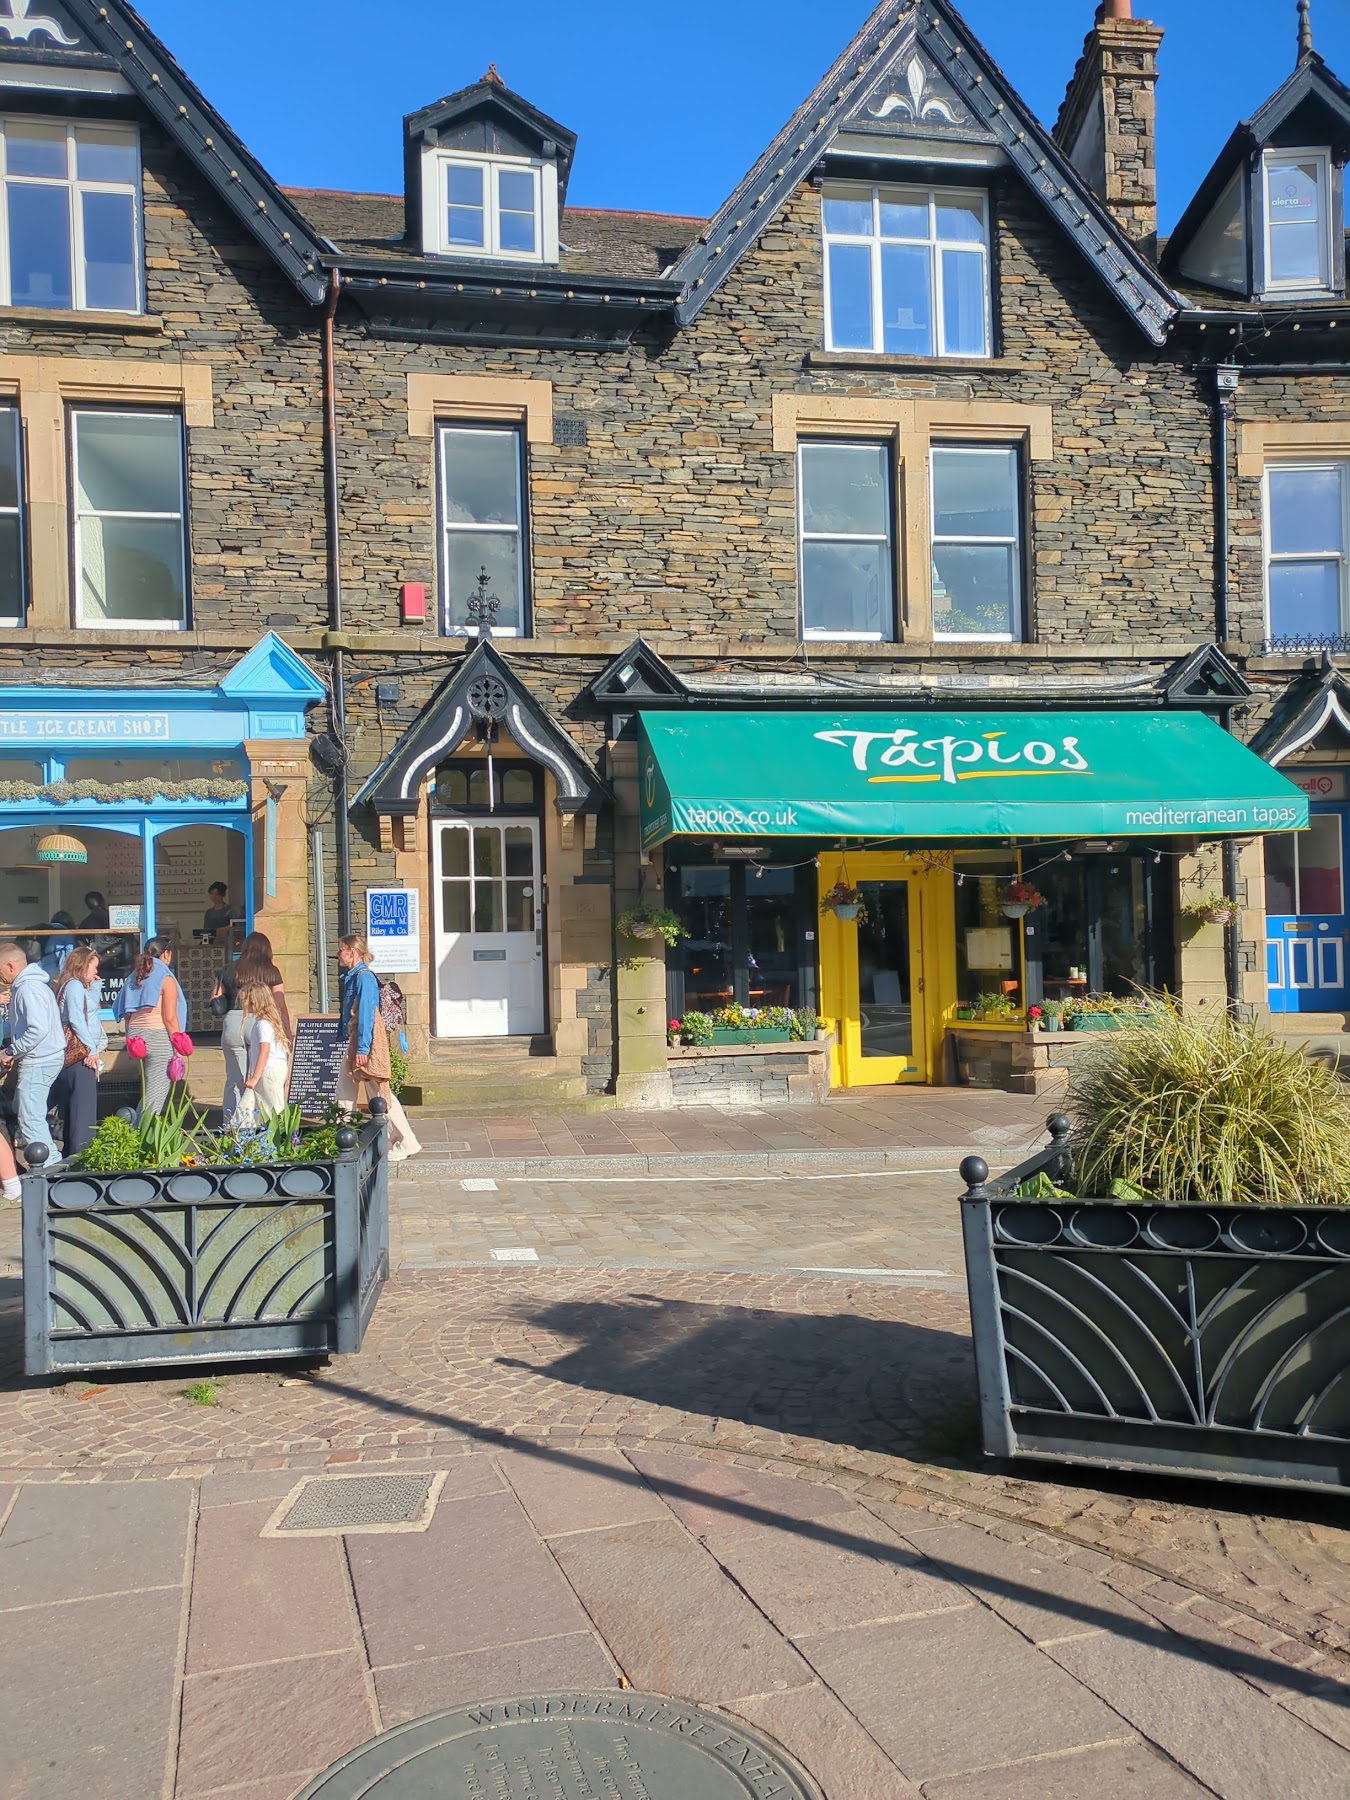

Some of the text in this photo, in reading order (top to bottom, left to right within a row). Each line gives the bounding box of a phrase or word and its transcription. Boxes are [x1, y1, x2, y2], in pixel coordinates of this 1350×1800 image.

[37, 720, 64, 735] ICE
[68, 719, 117, 736] CREAM
[123, 720, 162, 735] SHOP
[813, 729, 1089, 784] Tapios
[687, 804, 798, 828] tapios.co.uk
[1126, 806, 1297, 826] mediterranean tapas
[370, 895, 407, 918] GMR
[409, 894, 417, 935] Solicitors Ltd
[114, 917, 139, 925] OPEN
[371, 917, 396, 926] Graham
[371, 926, 408, 936] Riley & Co.
[110, 978, 127, 989] MA
[465, 1700, 794, 1800] WINDERMERE ENHA
[556, 1725, 593, 1794] Windermere
[612, 1735, 634, 1761] This
[463, 1763, 477, 1775] to
[541, 1760, 561, 1783] also
[593, 1756, 612, 1774] the
[517, 1764, 536, 1791] time
